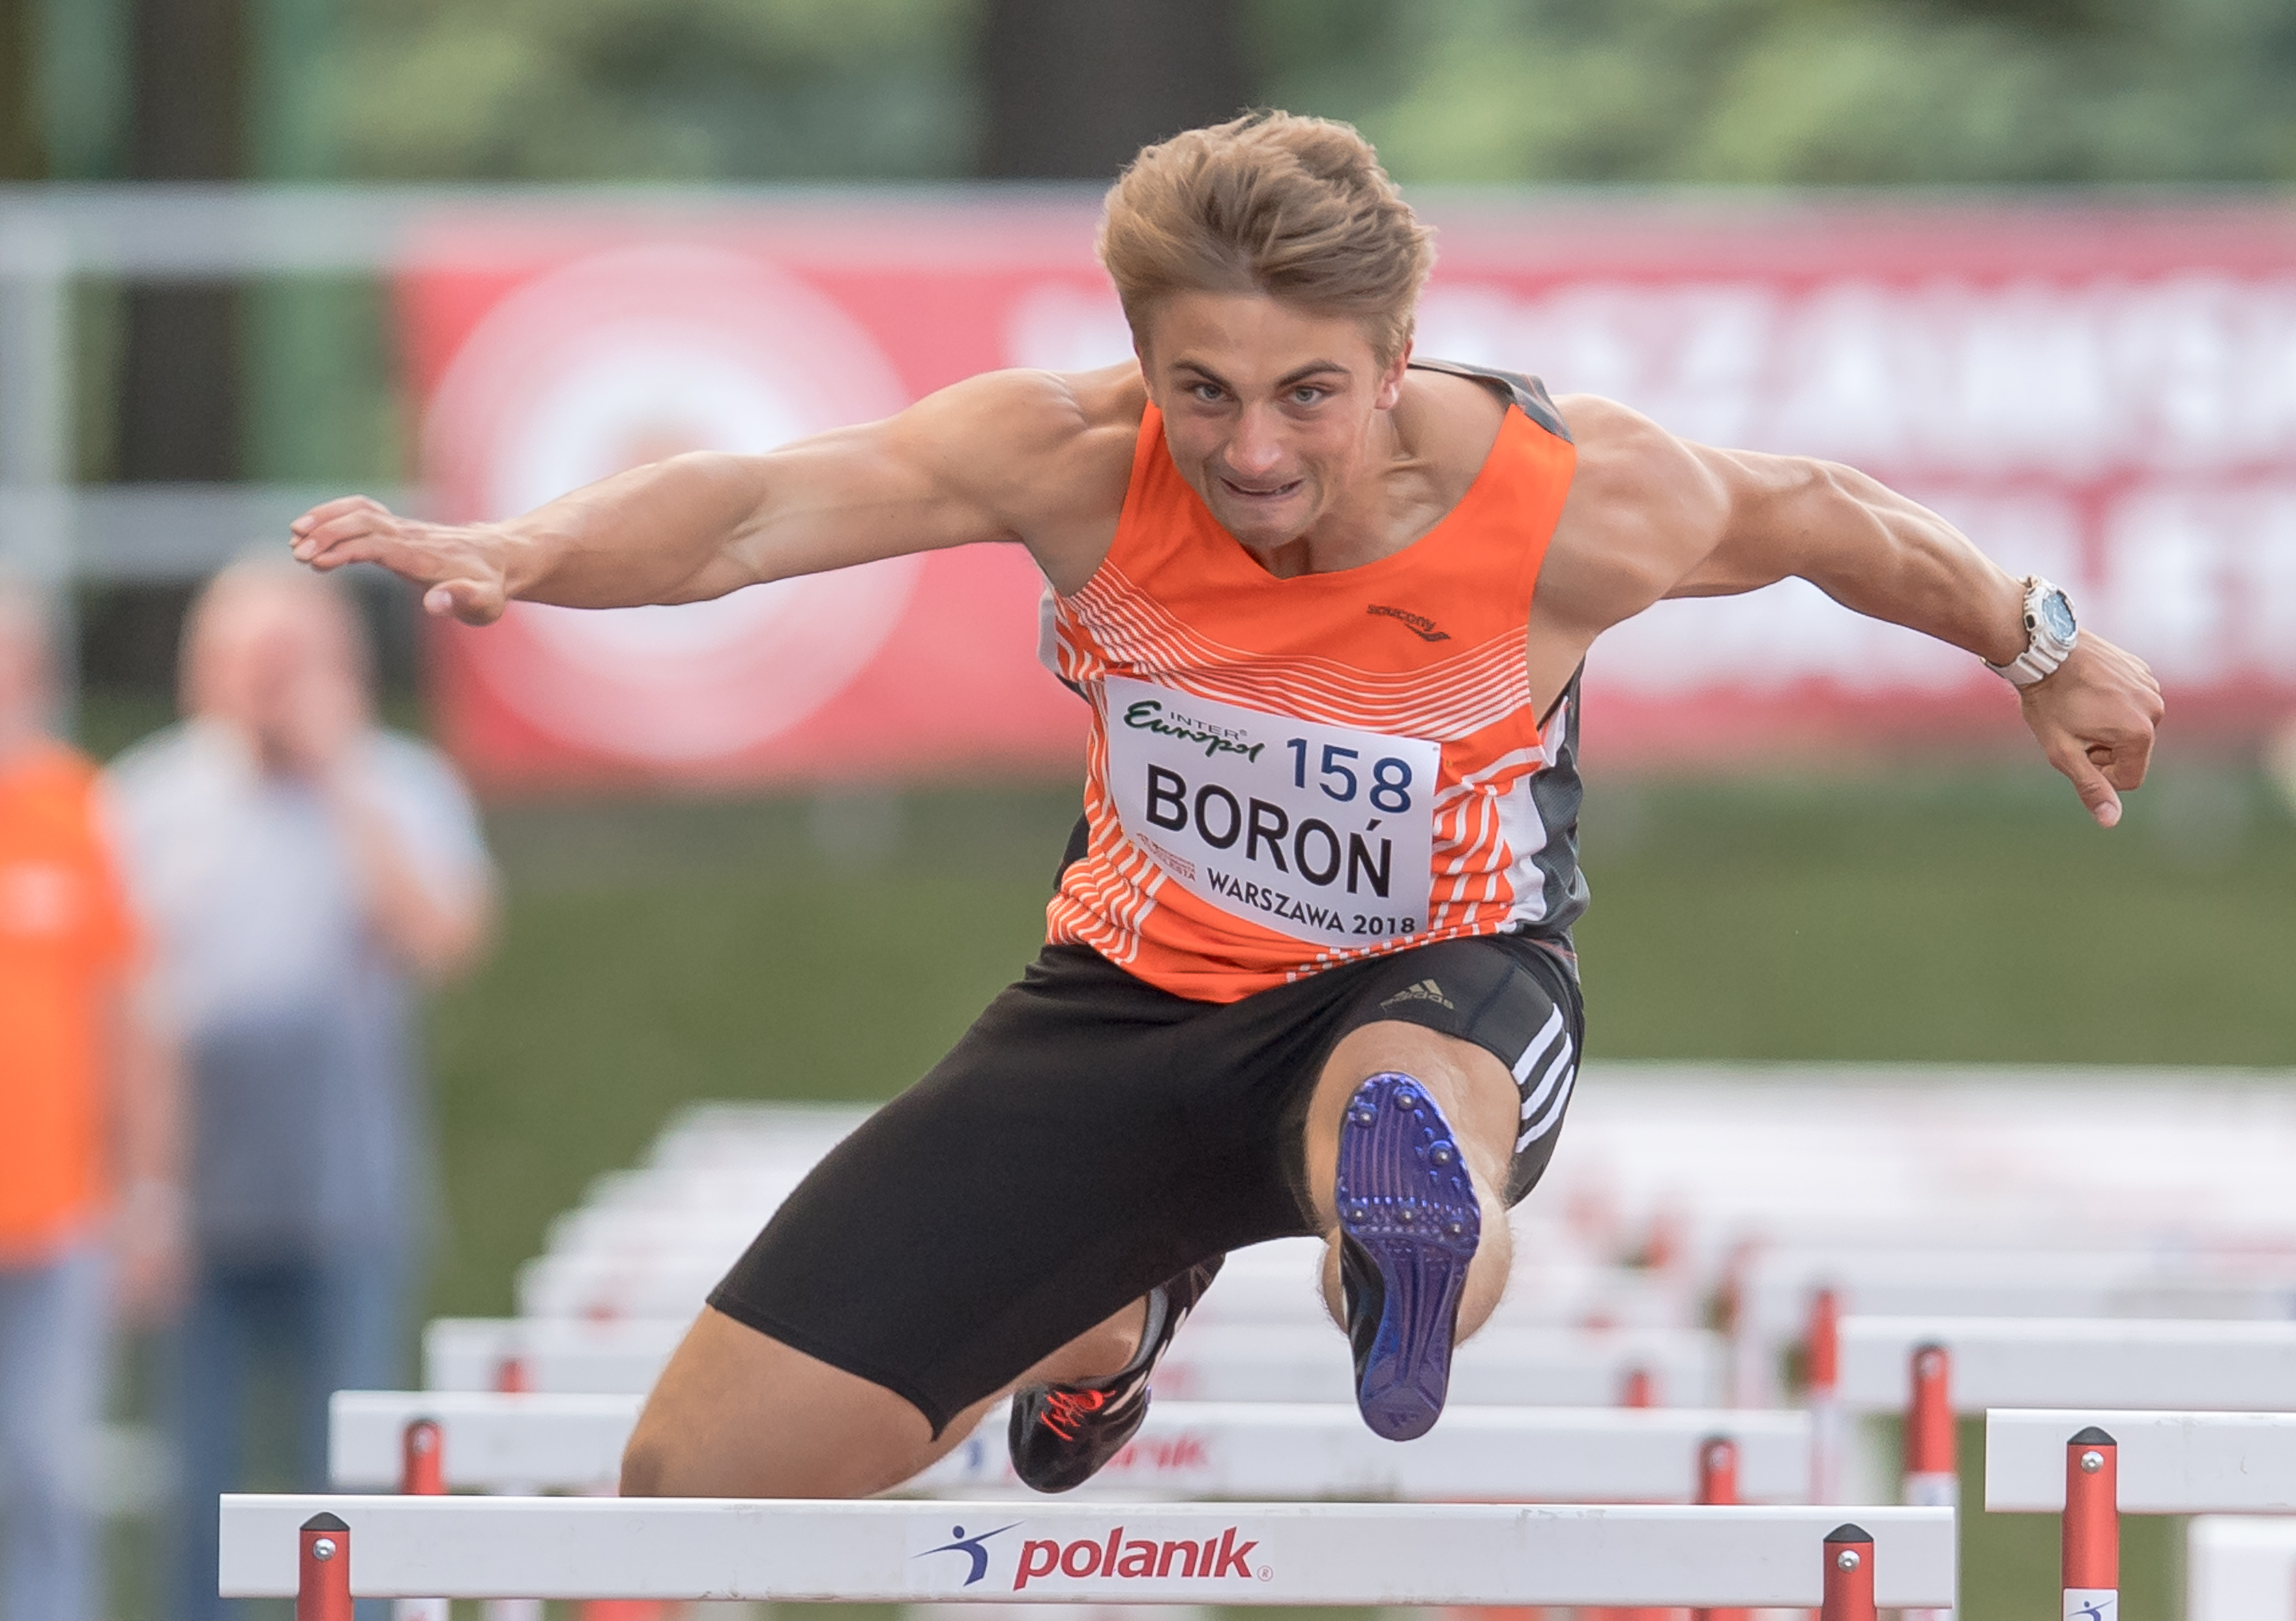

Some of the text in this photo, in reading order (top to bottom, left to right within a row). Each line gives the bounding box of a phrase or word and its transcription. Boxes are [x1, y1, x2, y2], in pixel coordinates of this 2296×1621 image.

[1286, 737, 1413, 814] 158
[1145, 763, 1392, 899] BOROŃ
[1207, 867, 1415, 936] WARSZAWA 2018
[1013, 1526, 1259, 1592] polanik
